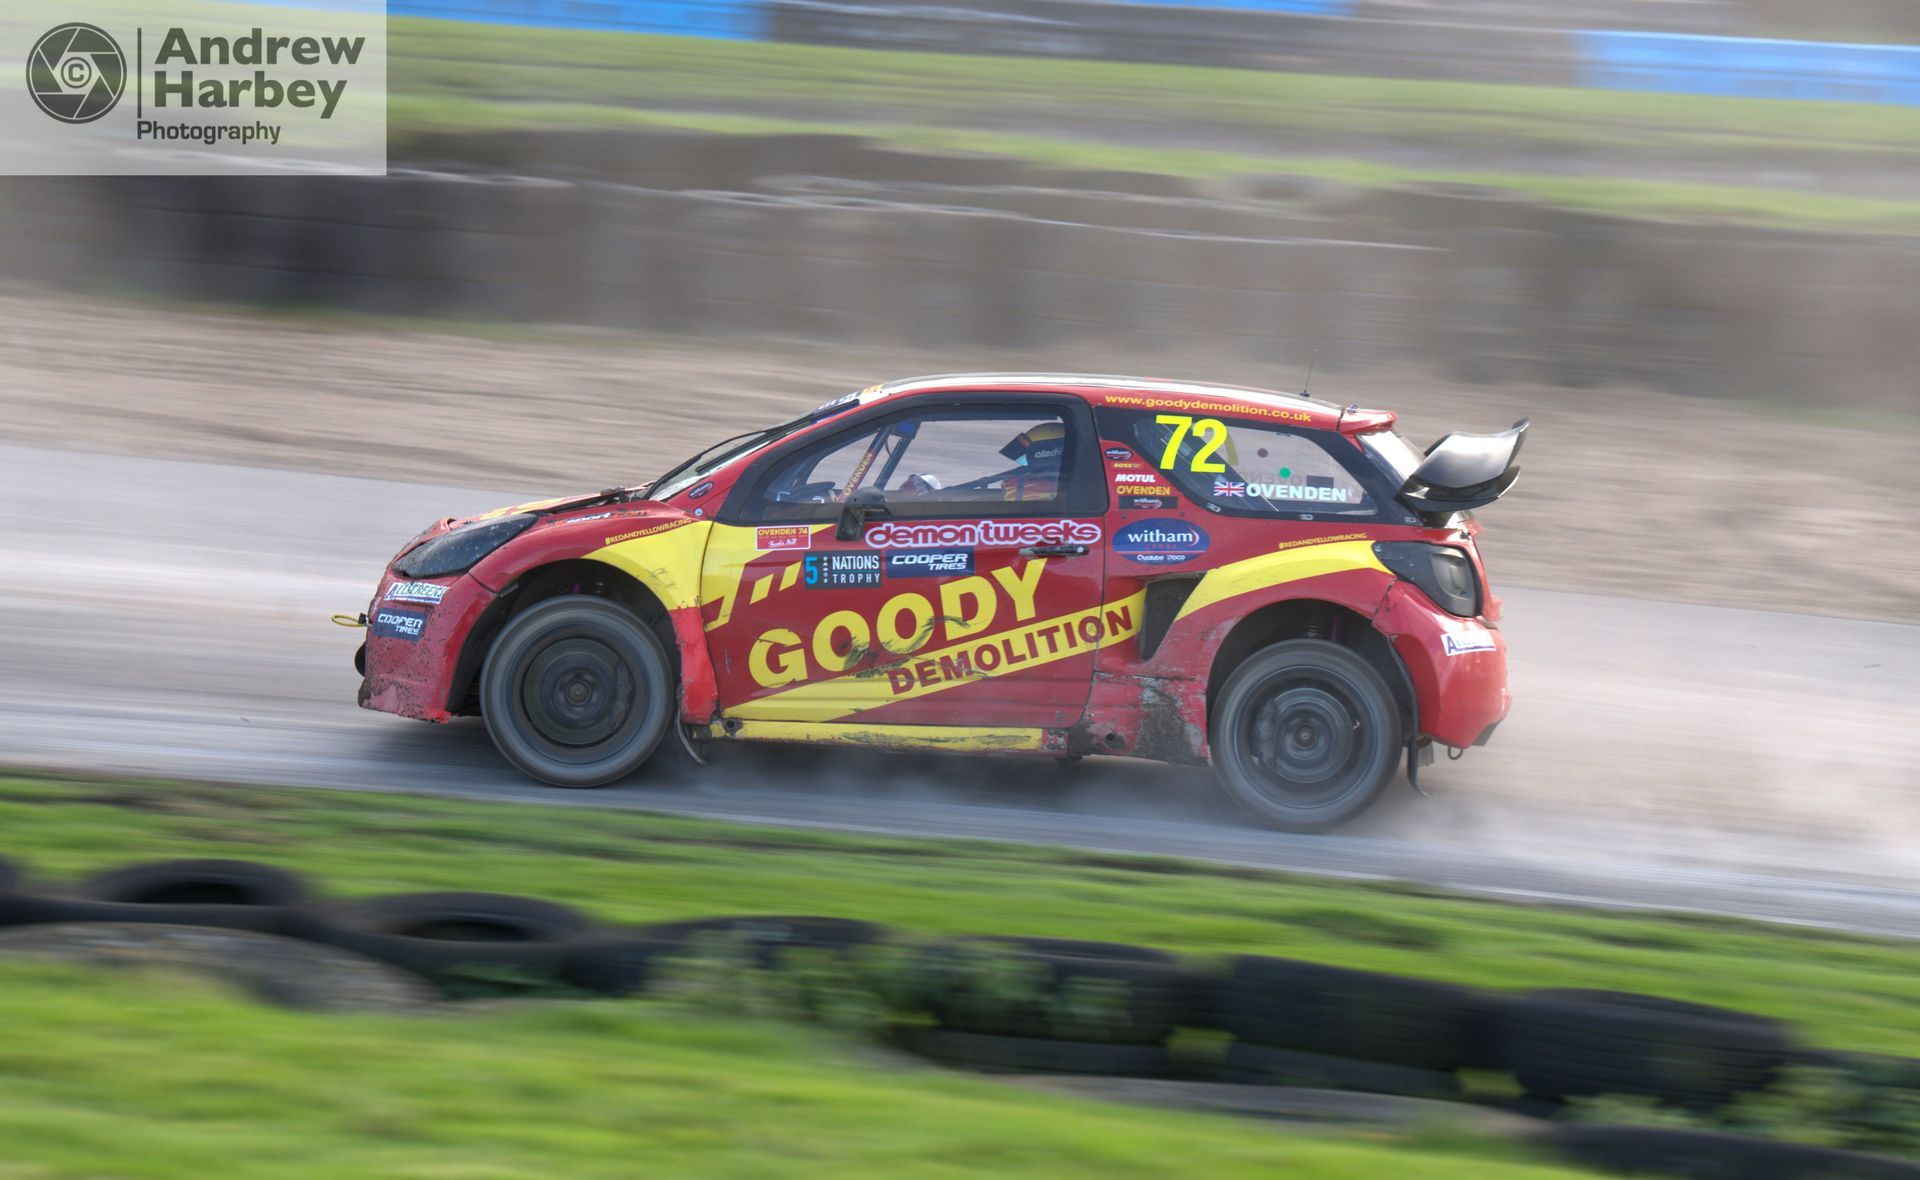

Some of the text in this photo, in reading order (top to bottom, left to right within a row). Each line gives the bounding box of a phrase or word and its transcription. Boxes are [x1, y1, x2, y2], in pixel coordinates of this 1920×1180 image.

[1105, 395, 1311, 422] www.goodydemolition.co.uk
[1156, 415, 1228, 473] 72
[1115, 474, 1156, 482] MOTUL
[1116, 485, 1171, 496] OVENDEN
[1246, 483, 1346, 501] OVENDEN
[605, 519, 692, 545] #REDANDYELLOWRACING
[758, 528, 796, 536] OVENDEN
[1128, 529, 1193, 542] witham
[1279, 532, 1368, 549] #REDANDYELLOWRACING
[892, 553, 968, 565] COOPER
[805, 556, 818, 584] 5
[832, 555, 880, 570] NATIONS
[928, 563, 967, 571] TIRES
[832, 573, 880, 584] TROPHY
[378, 613, 424, 628] COOPER
[748, 558, 1047, 688] GOODY
[395, 625, 421, 635] TIRES
[887, 605, 1133, 695] DEMOLITION
